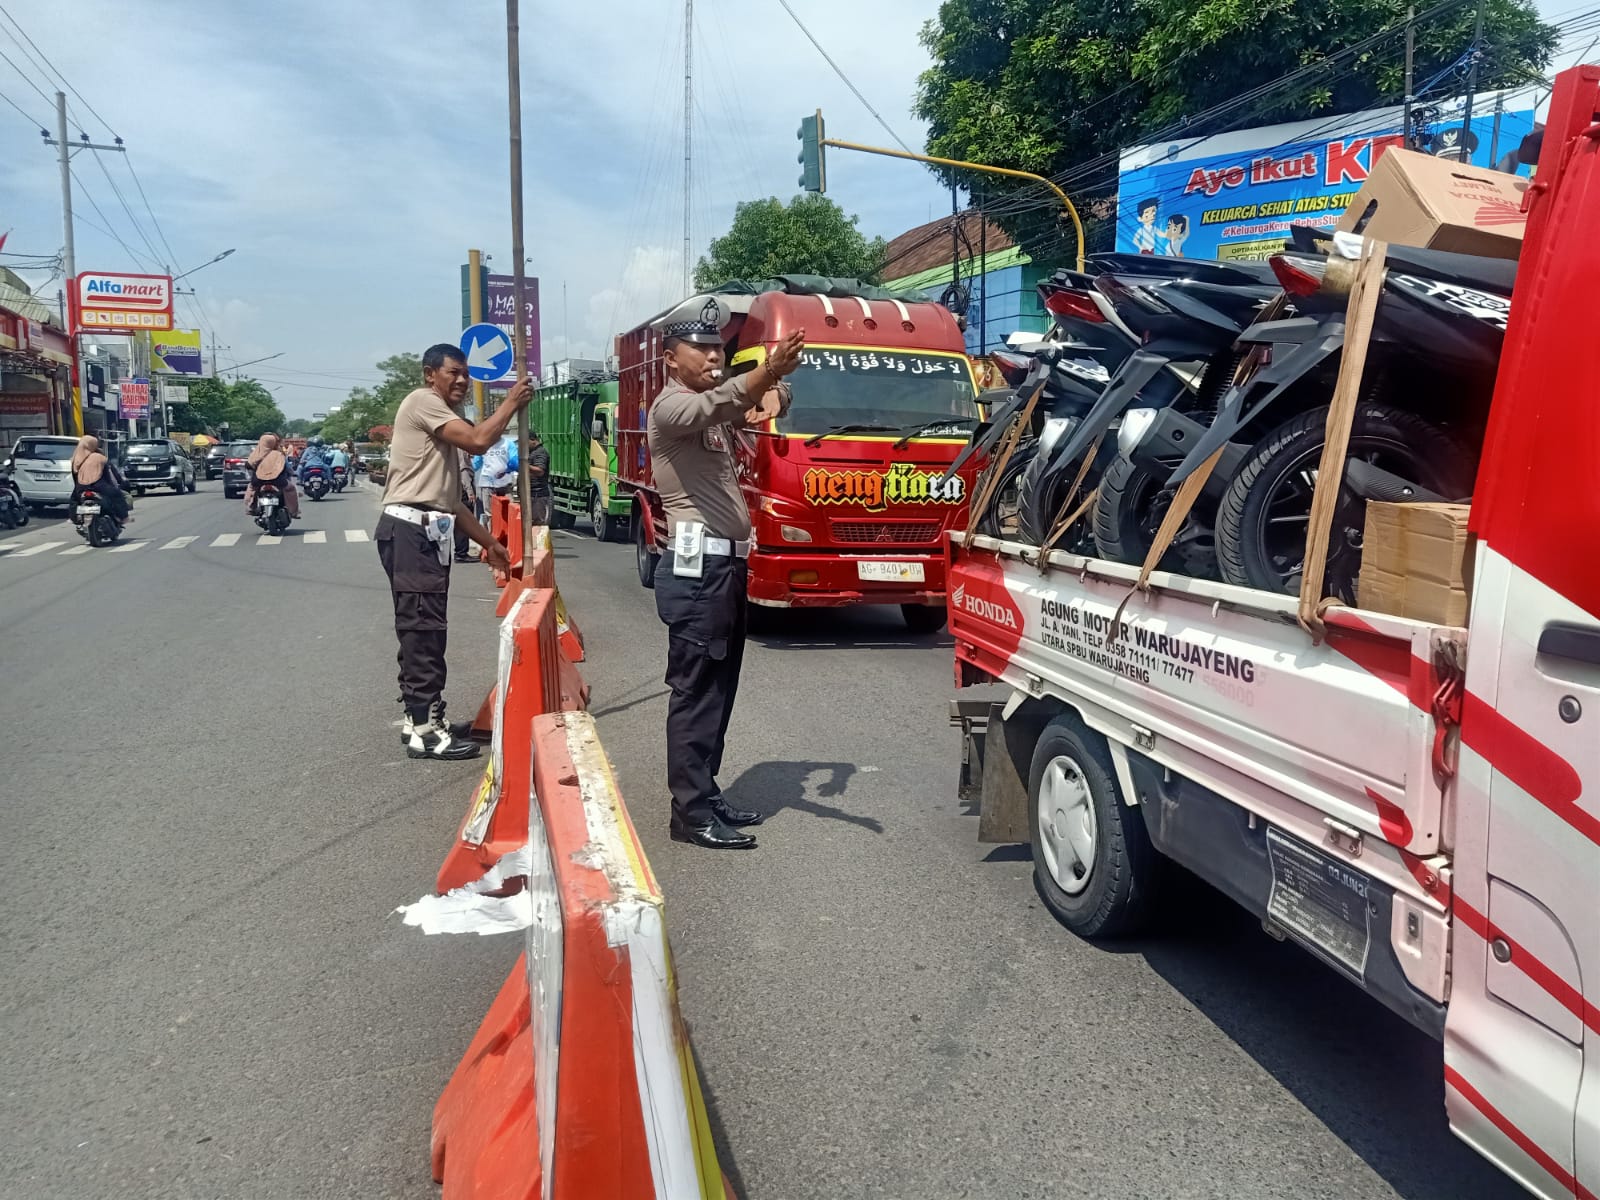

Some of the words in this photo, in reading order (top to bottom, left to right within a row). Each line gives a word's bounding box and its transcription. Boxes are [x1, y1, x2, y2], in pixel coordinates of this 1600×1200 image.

[1184, 167, 1245, 196] Ayo
[1250, 152, 1317, 184] Ikut
[1202, 204, 1257, 225] KELUARGA
[1258, 198, 1294, 217] SEHAT
[1295, 195, 1329, 212] ATASI
[1330, 193, 1359, 209] STU
[87, 279, 164, 297] Alfamart
[804, 468, 887, 512] neng
[885, 464, 966, 505] tiara
[965, 594, 1017, 630] HONDA
[1041, 598, 1079, 625] AGUNG
[1135, 627, 1254, 683] WARUJAYENG
[1041, 632, 1065, 652] UTARA
[1066, 642, 1087, 659] SPBU
[1089, 651, 1150, 684] WARUJAYENG
[1083, 632, 1103, 649] TELP
[1162, 661, 1194, 684] 77477
